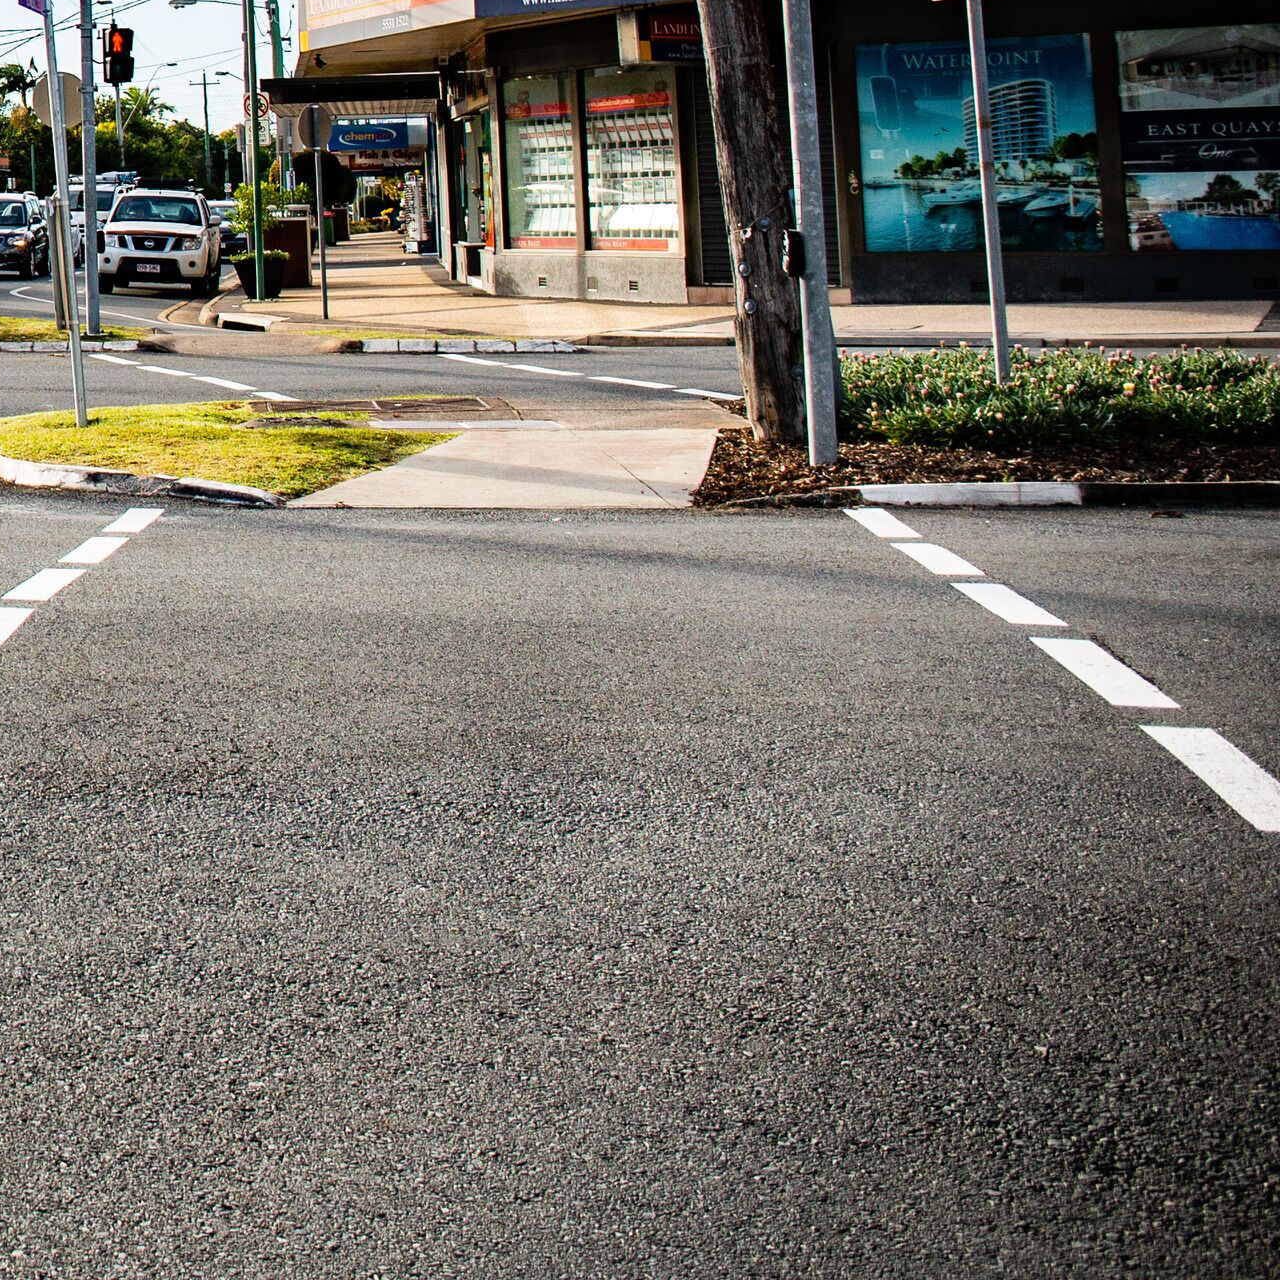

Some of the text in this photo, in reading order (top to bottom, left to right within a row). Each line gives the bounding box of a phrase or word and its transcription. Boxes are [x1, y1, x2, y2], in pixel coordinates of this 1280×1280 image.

[654, 20, 700, 35] LANDLIN
[903, 50, 1043, 69] WATEROINT
[1147, 120, 1280, 137] EAST QUAY
[358, 149, 420, 161] Fish & Chips
[1198, 143, 1233, 159] One
